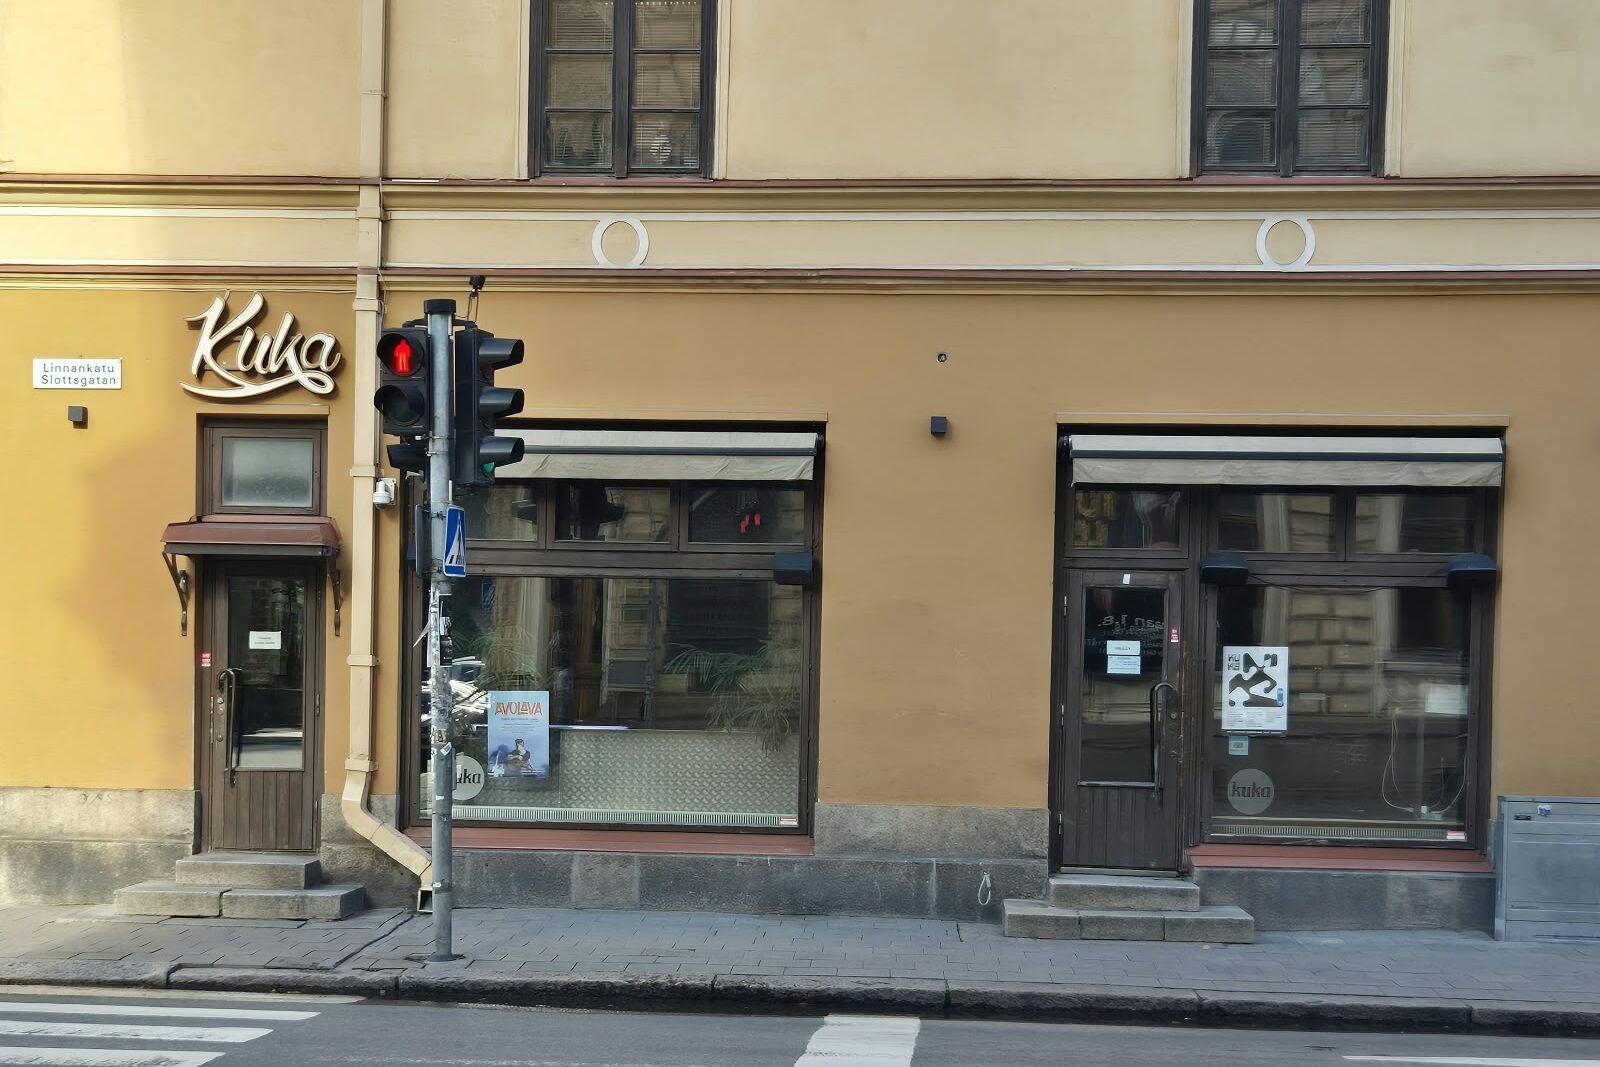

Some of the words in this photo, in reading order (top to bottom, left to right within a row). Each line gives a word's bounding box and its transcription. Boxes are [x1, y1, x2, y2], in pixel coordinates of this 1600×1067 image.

[180, 291, 342, 400] Kuka
[43, 362, 115, 373] Linnankatu
[41, 374, 117, 387] Slottsgatan
[495, 701, 542, 715] AVOLAVA
[456, 768, 481, 784] uka
[1231, 782, 1272, 798] kuka
